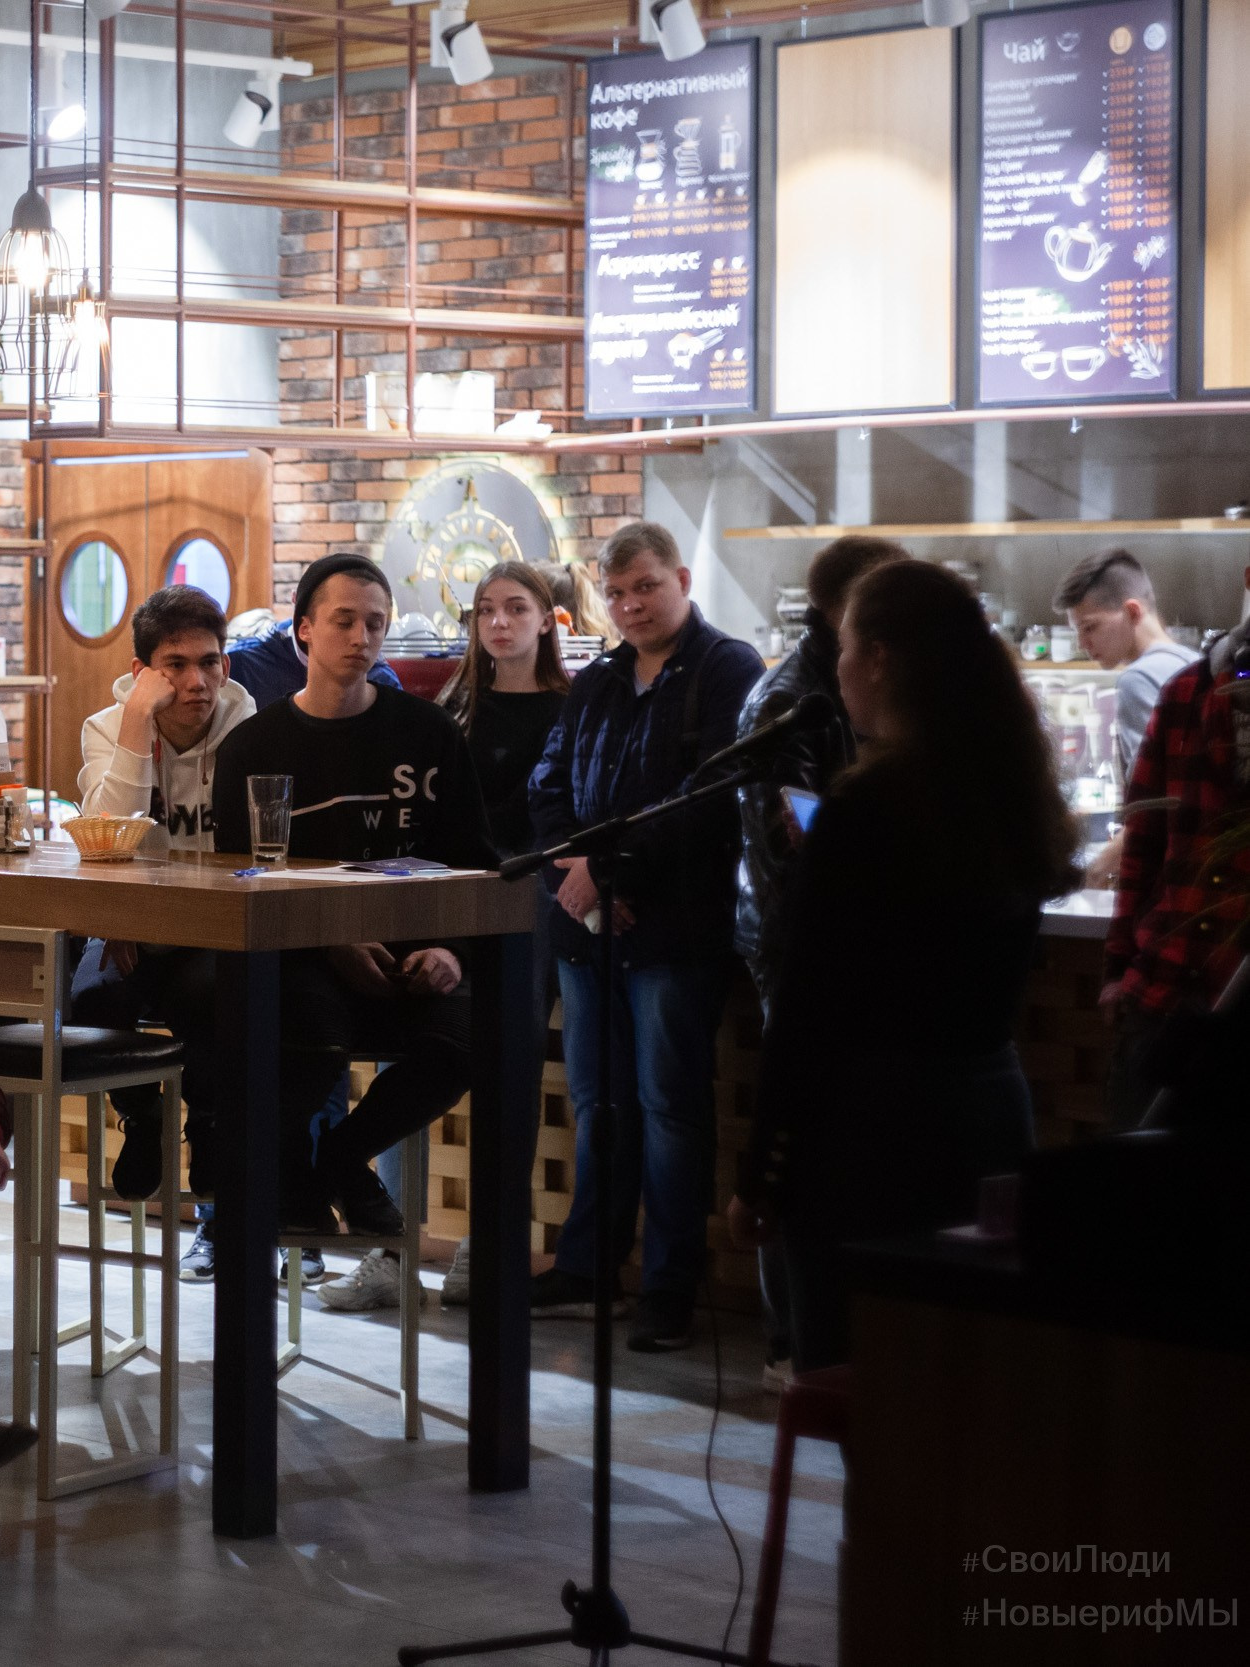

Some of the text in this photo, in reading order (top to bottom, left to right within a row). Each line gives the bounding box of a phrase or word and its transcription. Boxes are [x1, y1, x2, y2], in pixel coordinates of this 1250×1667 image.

[1003, 37, 1047, 64] Чай
[590, 65, 749, 104] Альтернативный
[590, 105, 639, 131] кофе
[597, 252, 702, 280] Аэропресс
[590, 303, 740, 337] Австралийский
